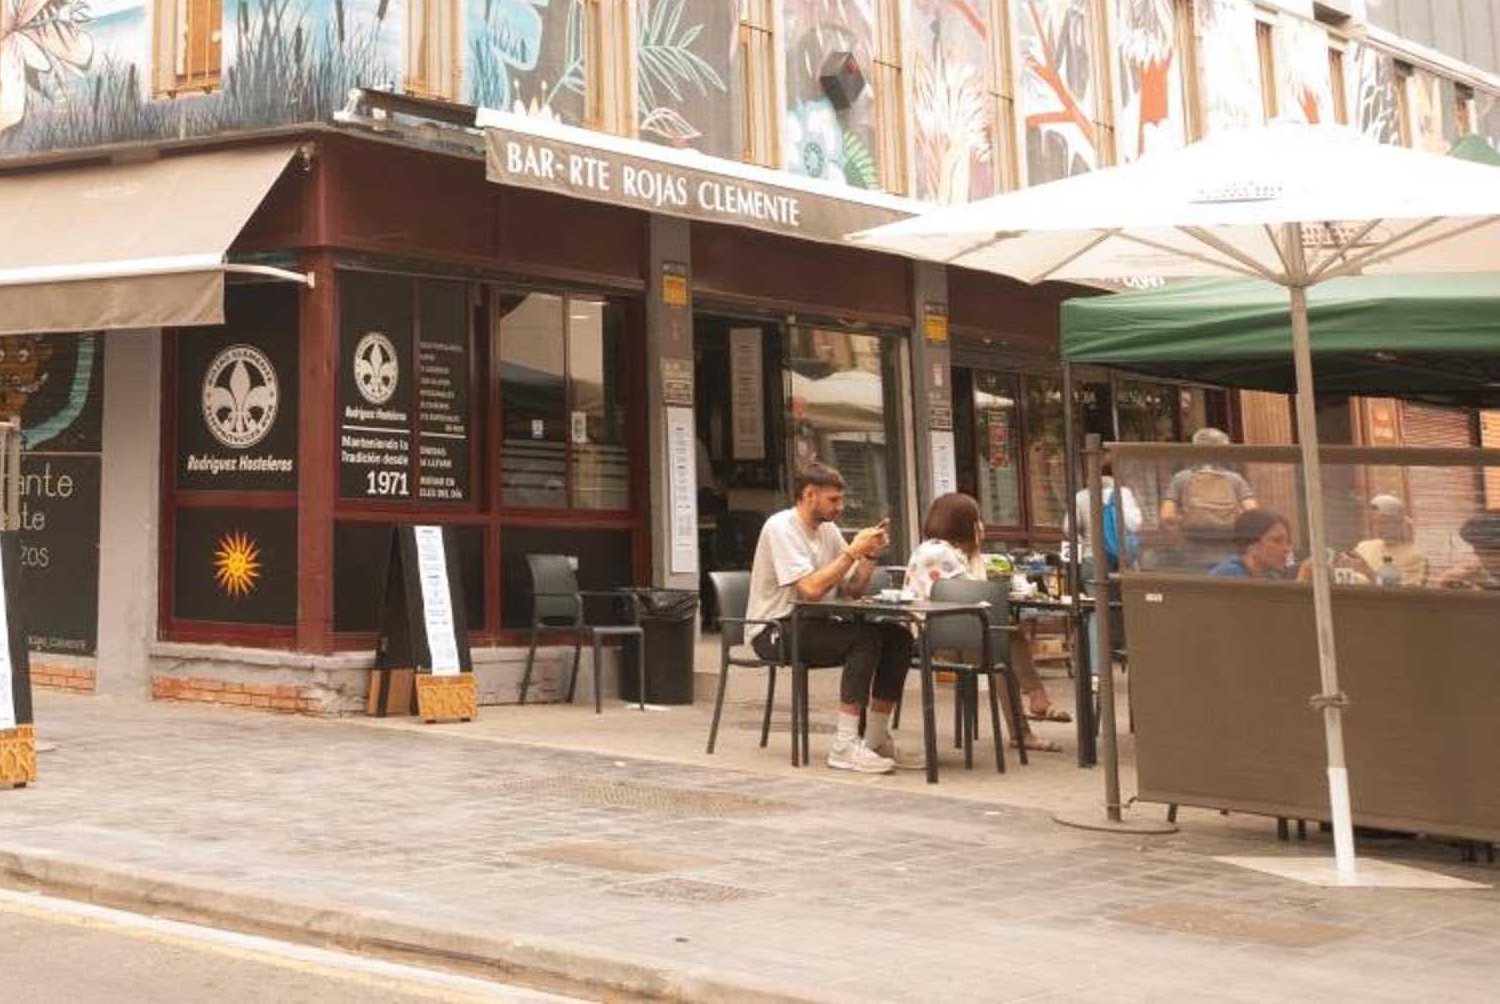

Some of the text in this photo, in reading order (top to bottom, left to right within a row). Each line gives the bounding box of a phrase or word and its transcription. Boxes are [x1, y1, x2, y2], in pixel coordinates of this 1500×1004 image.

[622, 166, 688, 207] ROJAS
[698, 181, 800, 227] CLEMENTE
[366, 470, 409, 495] 1971
